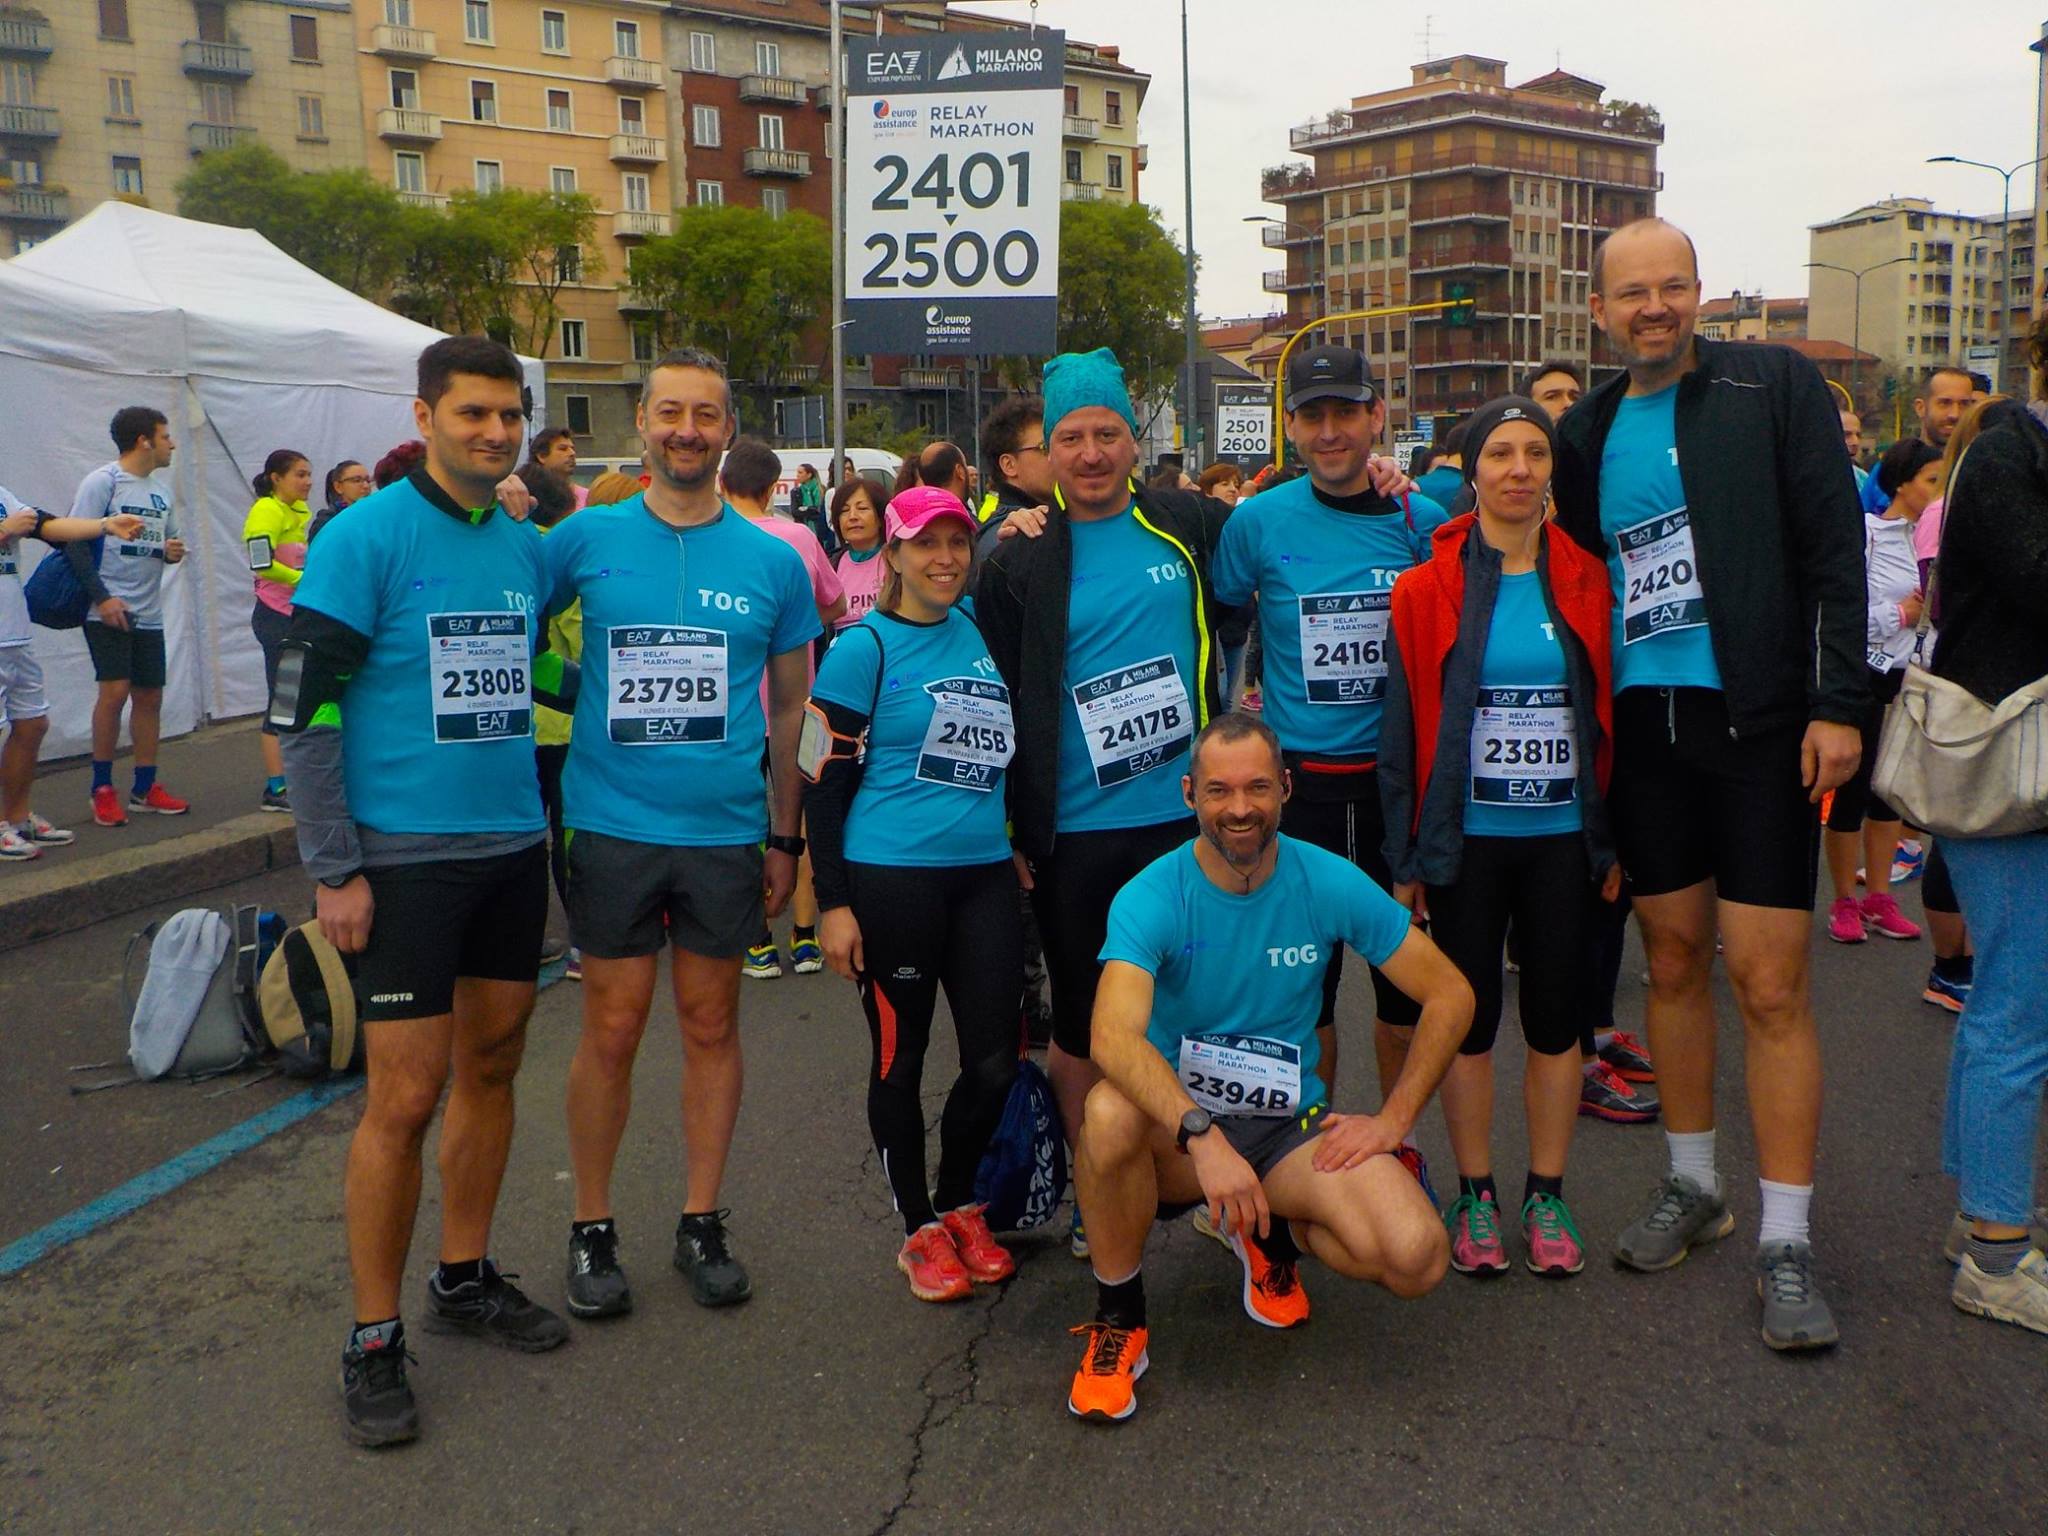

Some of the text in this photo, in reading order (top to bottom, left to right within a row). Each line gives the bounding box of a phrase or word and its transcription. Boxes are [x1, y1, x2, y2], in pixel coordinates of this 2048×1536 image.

[867, 50, 921, 76] EA7
[976, 48, 1043, 63] MILANO
[976, 61, 1043, 74] MARATHON
[891, 109, 918, 119] europ
[930, 105, 988, 121] RELAY
[873, 119, 918, 129] assistance
[930, 122, 1034, 138] MARATHON
[871, 151, 1031, 211] 2401
[862, 229, 1040, 289] 2500
[944, 315, 972, 326] europ
[926, 324, 971, 335] assistance
[1225, 420, 1264, 433] 2501
[1222, 438, 1266, 452] 2600
[1629, 527, 1652, 545] EA7
[1146, 560, 1188, 585] TOG
[1629, 559, 1693, 603] 2420
[698, 589, 750, 614] TOG
[1317, 599, 1341, 610] EA7
[1649, 601, 1687, 625] EA7
[448, 618, 473, 631] EA7
[1333, 623, 1379, 631] MARATHON
[627, 631, 707, 643] EA7 MILANO
[467, 648, 506, 656] MARATHON
[973, 655, 996, 677] TO
[442, 668, 526, 698] 2380B
[1090, 665, 1159, 695] EA7 MILANO
[1338, 679, 1376, 696] EA7
[618, 677, 718, 704] 2379B
[1110, 691, 1135, 705] RELAY
[1492, 692, 1519, 703] EA7
[1112, 692, 1156, 712] MARATHON
[476, 711, 510, 732] EA7
[646, 718, 688, 736] EA7
[1099, 705, 1181, 751] 2417B
[938, 722, 1007, 754] 2415B
[1129, 746, 1164, 770] EA7
[1484, 738, 1570, 764] 2381B
[953, 761, 991, 782] EA7
[1509, 780, 1550, 797] EA7
[1267, 944, 1318, 967] TOG
[370, 992, 414, 1003] KIPSTA
[1253, 1040, 1283, 1053] MILANO
[1218, 1050, 1246, 1061] RELAY
[1217, 1059, 1267, 1074] MARATHON
[1187, 1071, 1290, 1110] 2394B
